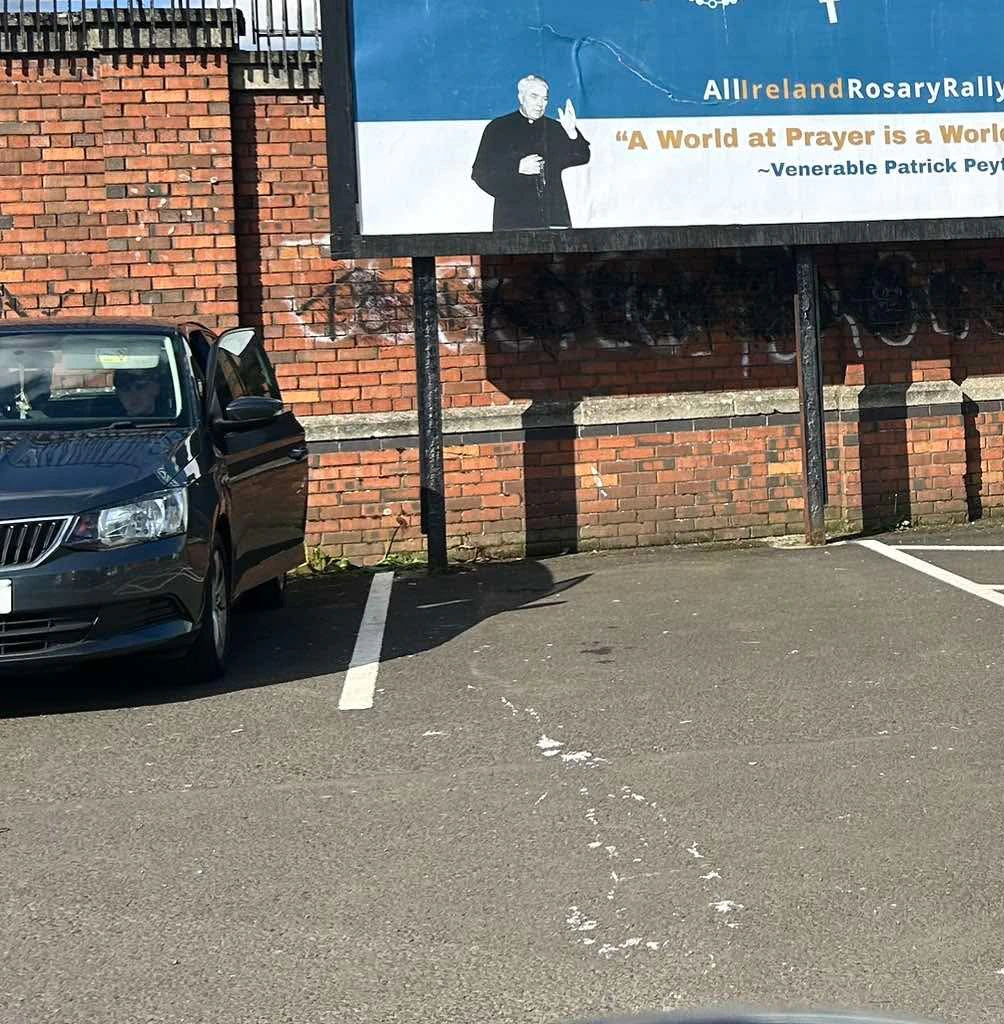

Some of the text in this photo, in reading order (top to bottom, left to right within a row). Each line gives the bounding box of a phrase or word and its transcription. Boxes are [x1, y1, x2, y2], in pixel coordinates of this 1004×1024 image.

[615, 130, 648, 150] “A
[657, 128, 738, 149] World
[748, 128, 776, 148] at
[786, 127, 875, 151] Prayer
[884, 125, 907, 145] is
[915, 127, 933, 145] a
[757, 160, 878, 177] ~Venerable
[885, 158, 957, 175] Patrick
